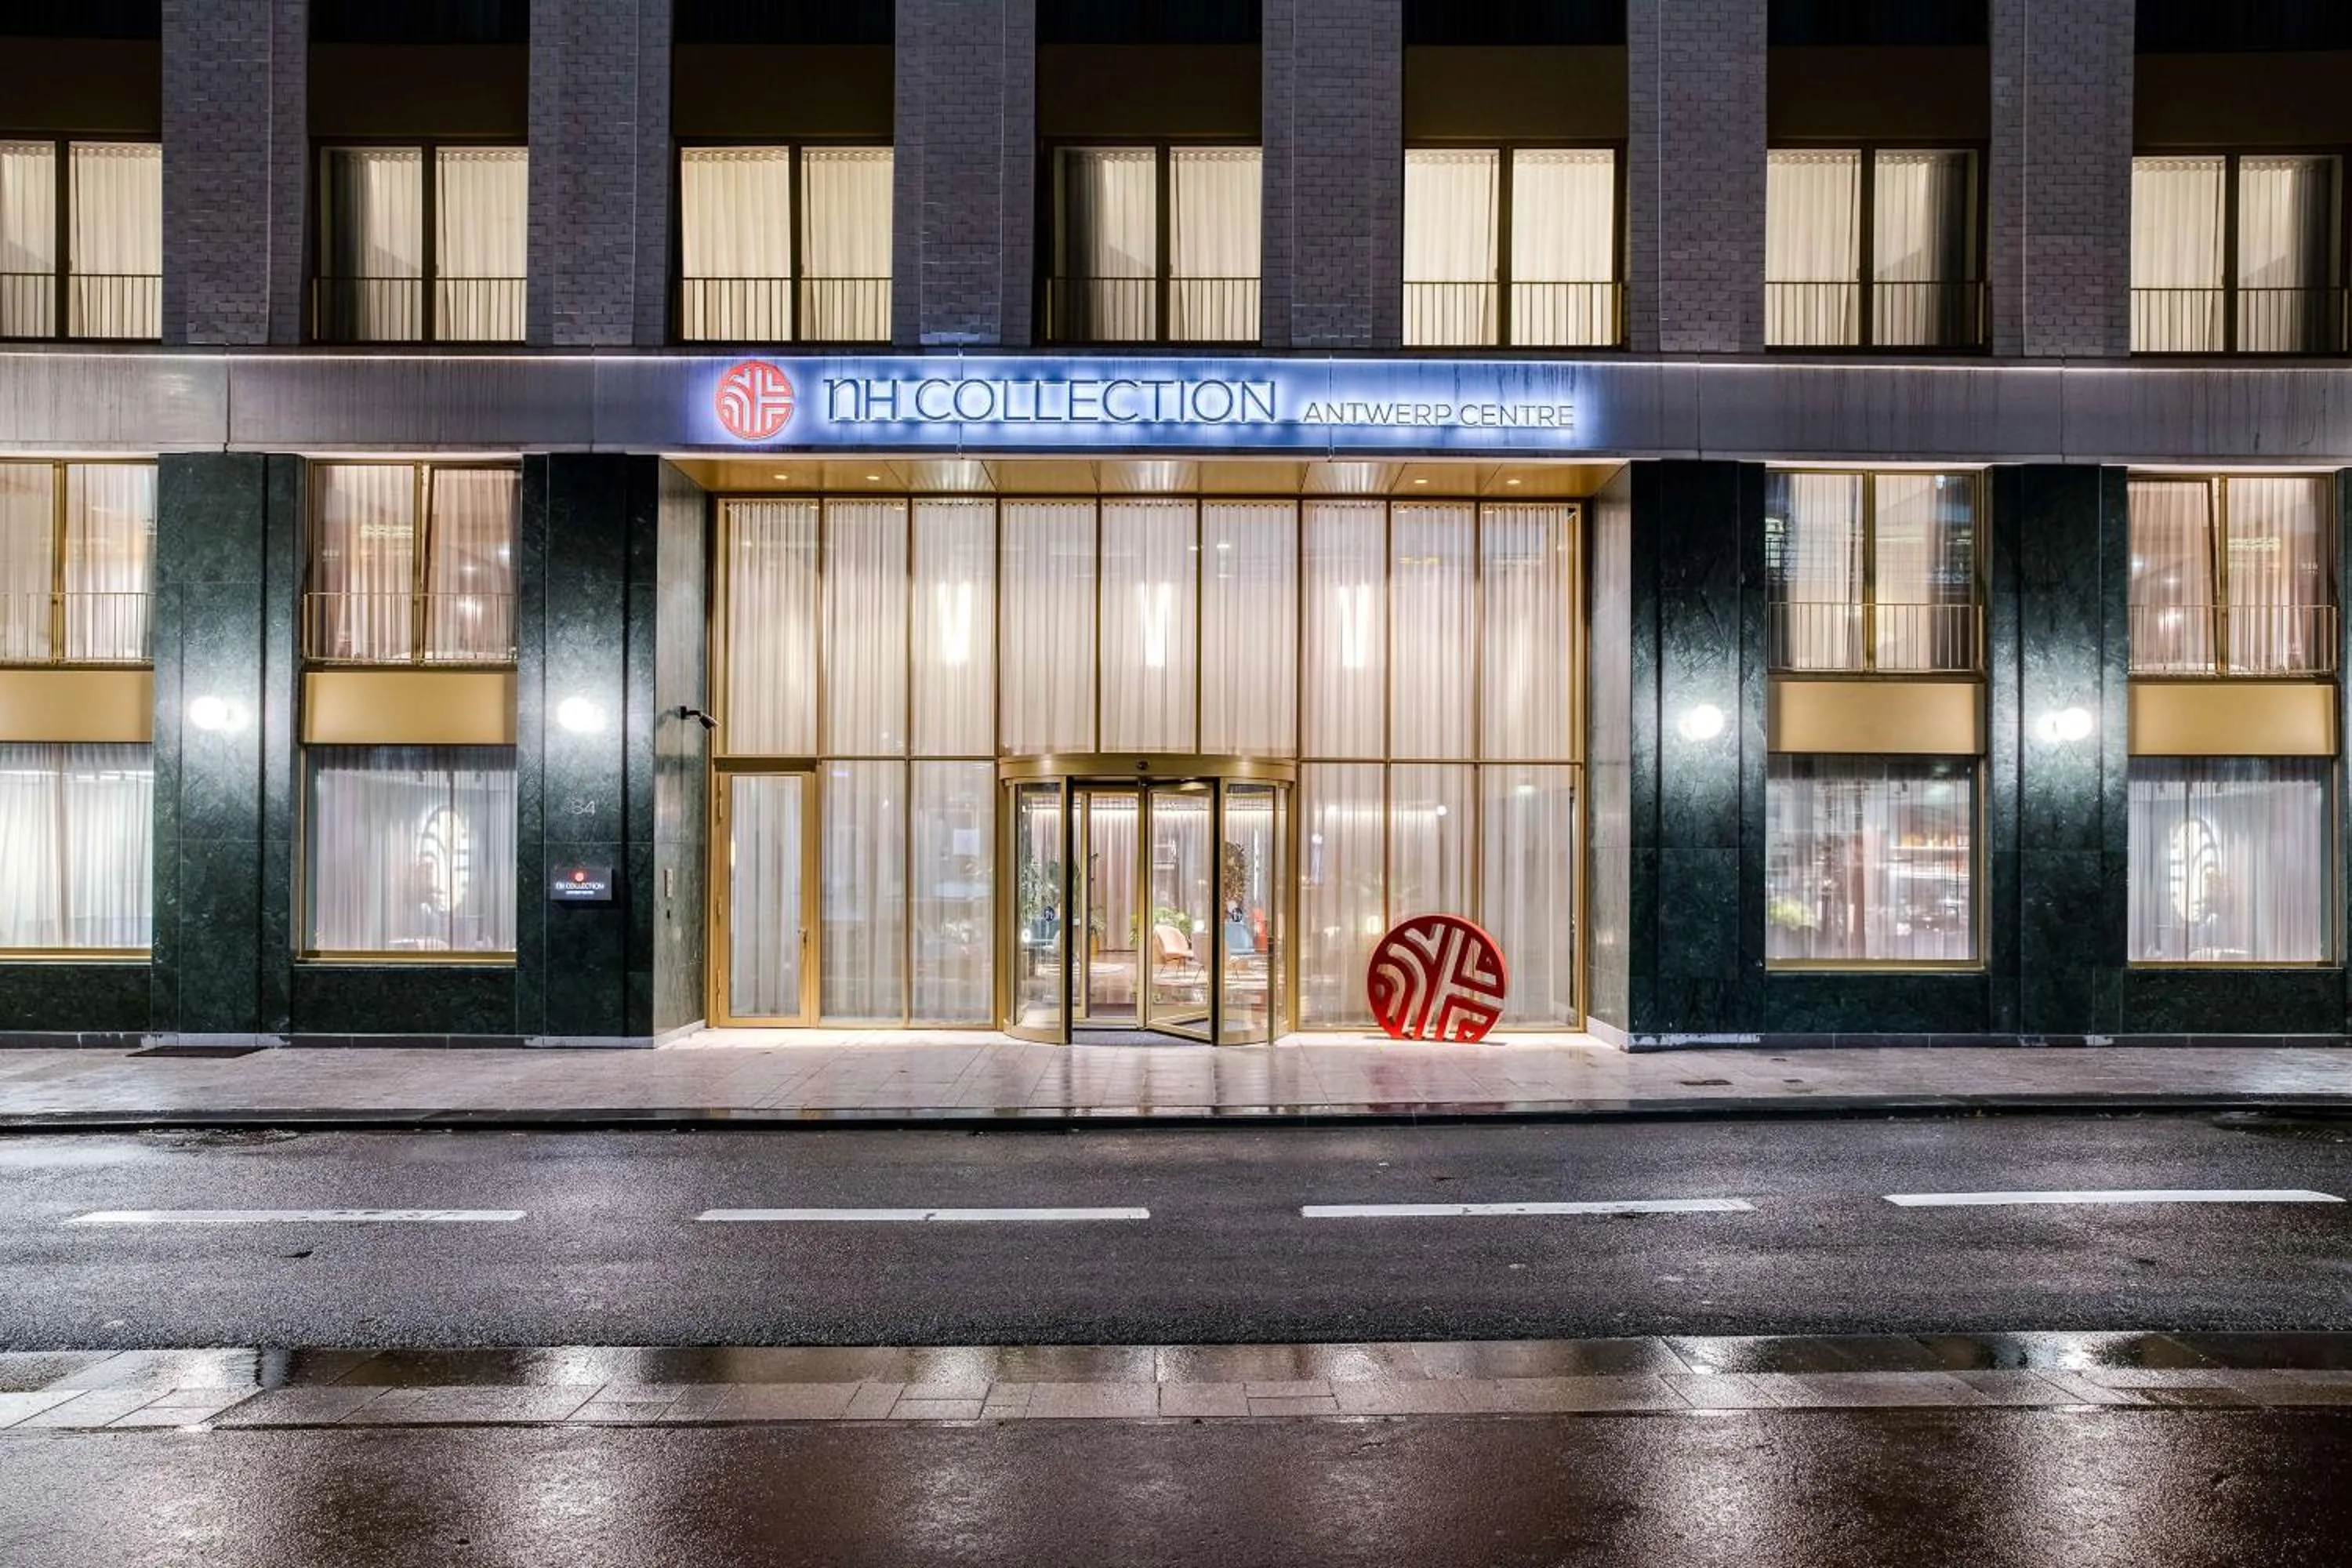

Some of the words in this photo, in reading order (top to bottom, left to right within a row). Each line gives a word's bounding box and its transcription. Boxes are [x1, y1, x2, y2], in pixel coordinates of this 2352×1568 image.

[915, 379, 1276, 422] COLLECTION
[1304, 401, 1452, 424] ANTWERP
[1460, 404, 1574, 426] CENTRE
